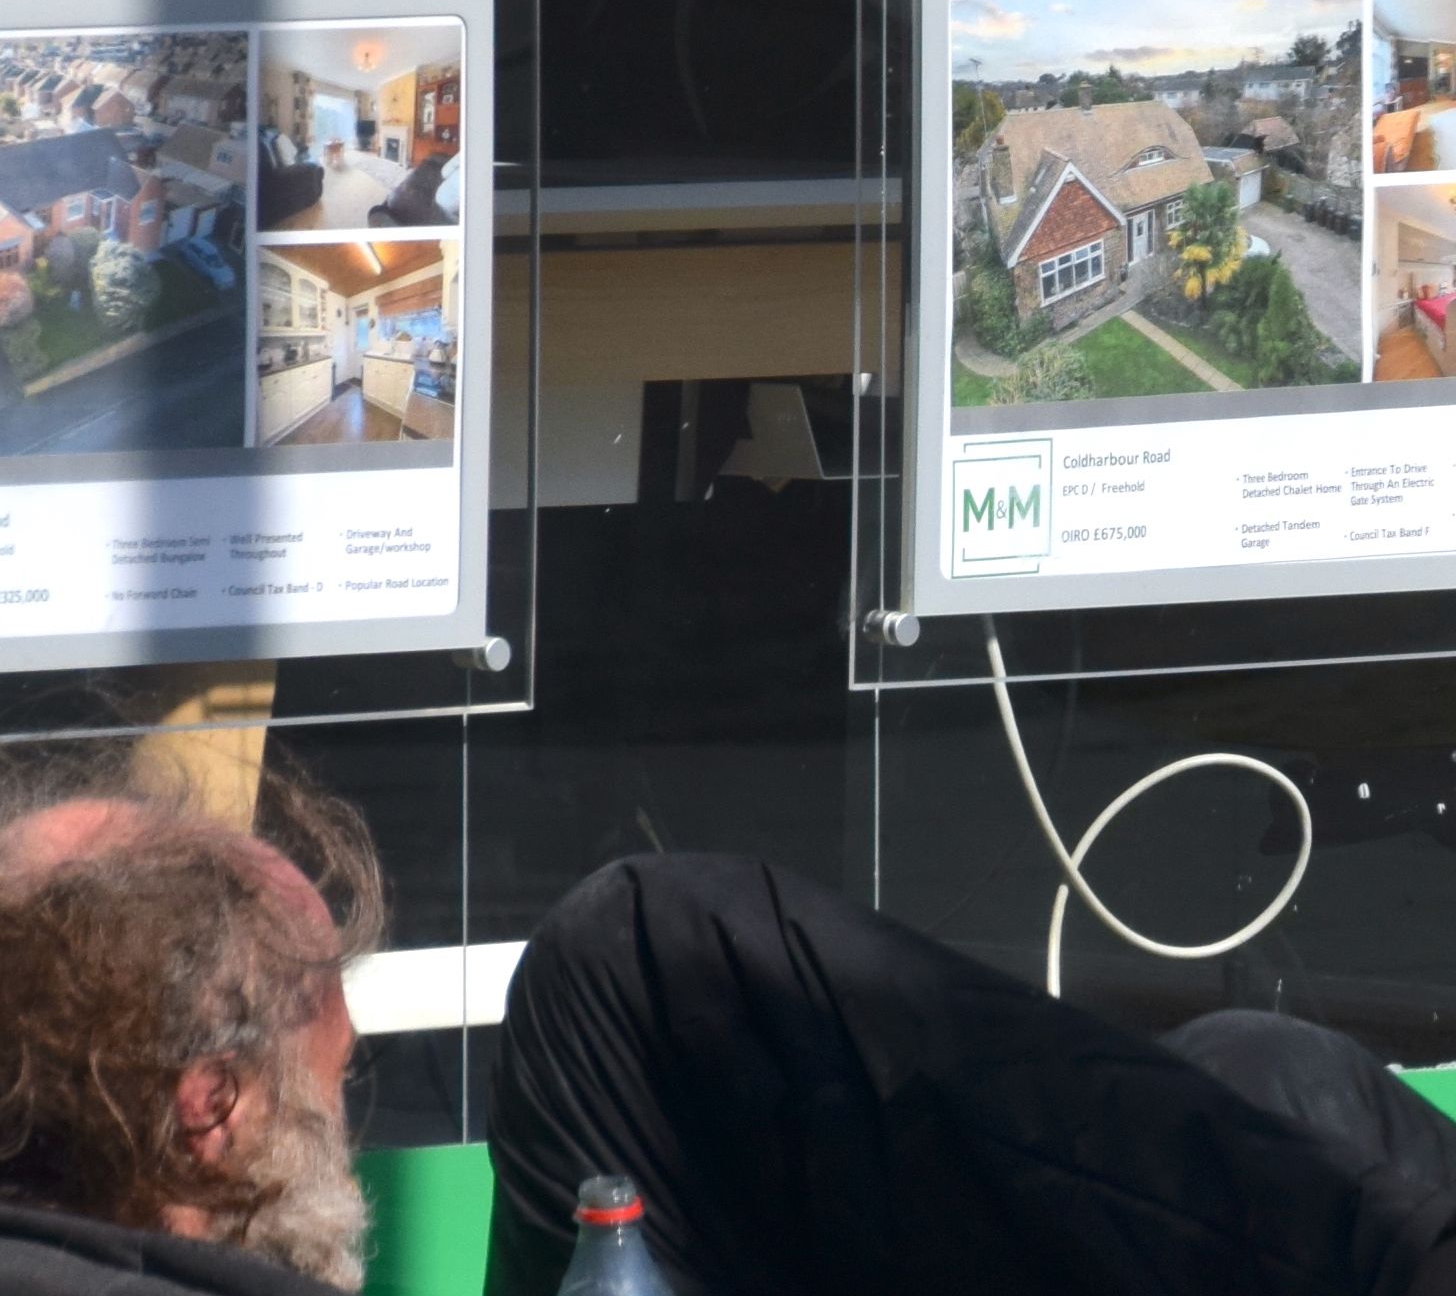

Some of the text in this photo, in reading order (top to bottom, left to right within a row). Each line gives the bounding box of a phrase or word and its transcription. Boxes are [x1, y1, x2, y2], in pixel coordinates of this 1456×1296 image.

[1063, 449, 1170, 469] Coldharbour Road
[1243, 471, 1308, 484] Three Bedroom
[1351, 464, 1427, 477] Entrance To Drive
[1063, 481, 1145, 496] EPC D Freehold
[1243, 484, 1342, 499] Detached Chalet Home
[1351, 477, 1434, 492] Through An Electric
[1351, 493, 1403, 506] Gate System
[963, 484, 1040, 532] M&M
[1242, 519, 1320, 534] Detached Tandem
[346, 528, 412, 540] Driveway And
[1062, 525, 1147, 543] OIRO £675,000
[1350, 527, 1422, 541] Council Tax Band
[346, 542, 431, 555] Garage/workshop
[1241, 537, 1270, 549] Garage
[228, 583, 309, 596] Council Tax Band
[345, 577, 448, 592] Popular Road Location
